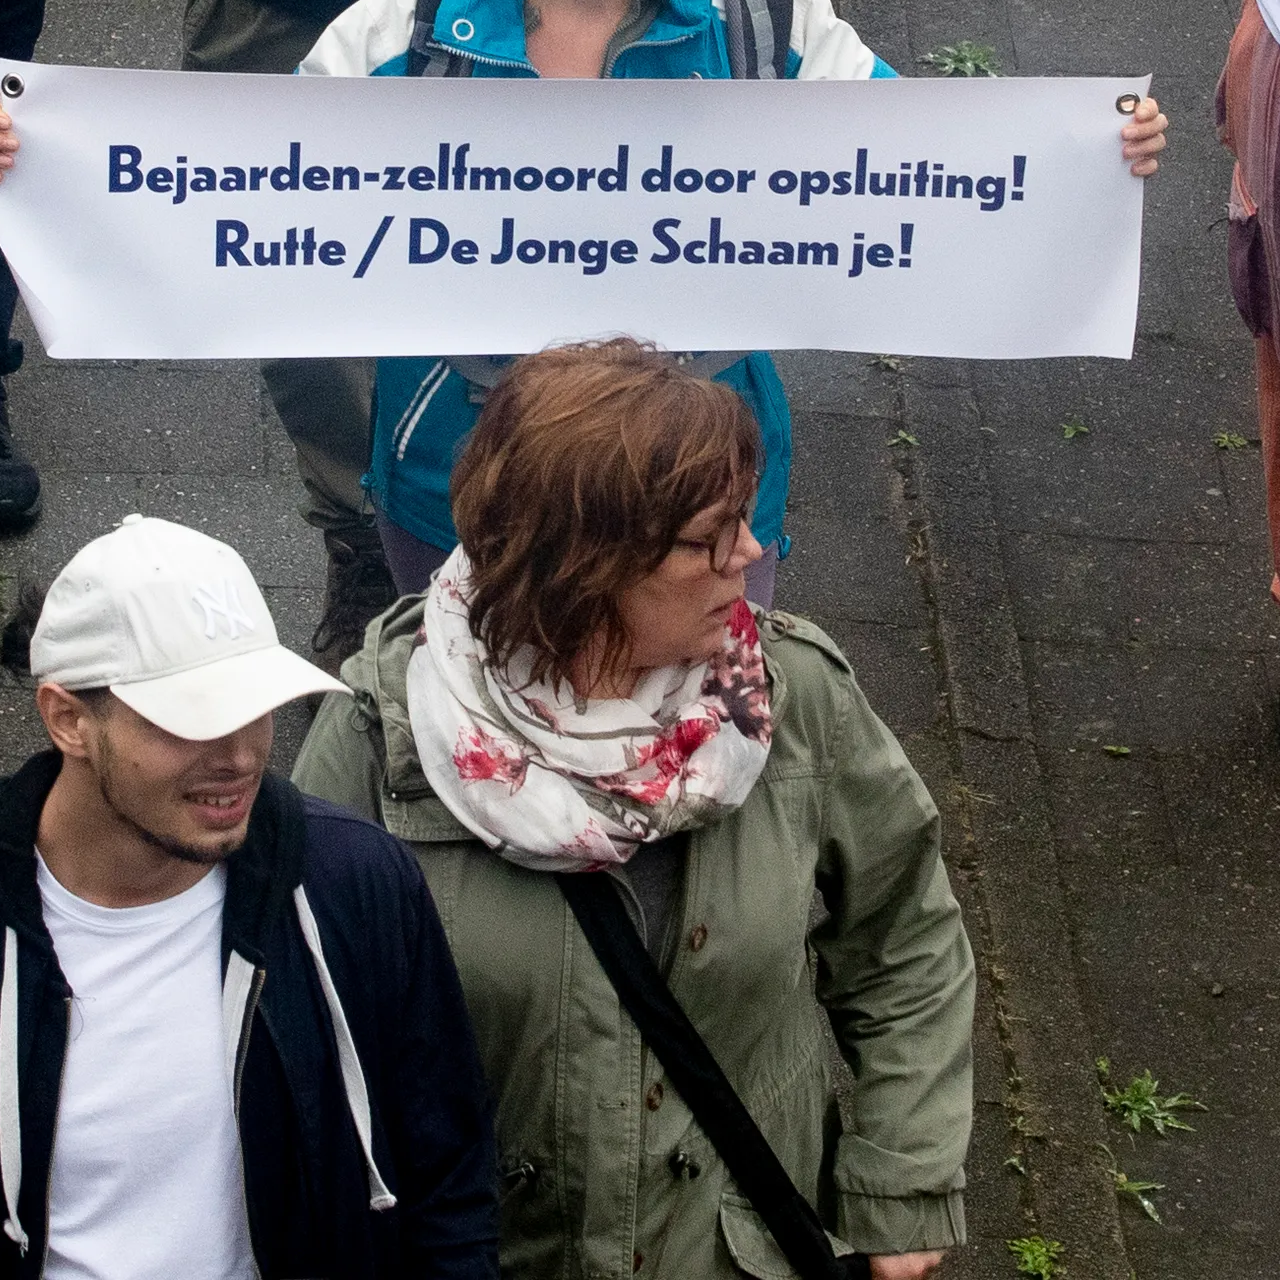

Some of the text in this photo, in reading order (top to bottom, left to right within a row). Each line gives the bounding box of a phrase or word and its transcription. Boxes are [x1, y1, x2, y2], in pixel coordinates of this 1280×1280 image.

[108, 142, 1027, 211] Bejaarden-zelfmoord door opsluiting!
[215, 220, 346, 267] Rutte
[408, 218, 479, 265] De
[490, 218, 638, 275] Jonge
[650, 217, 839, 265] Schaam
[848, 223, 914, 278] je!
